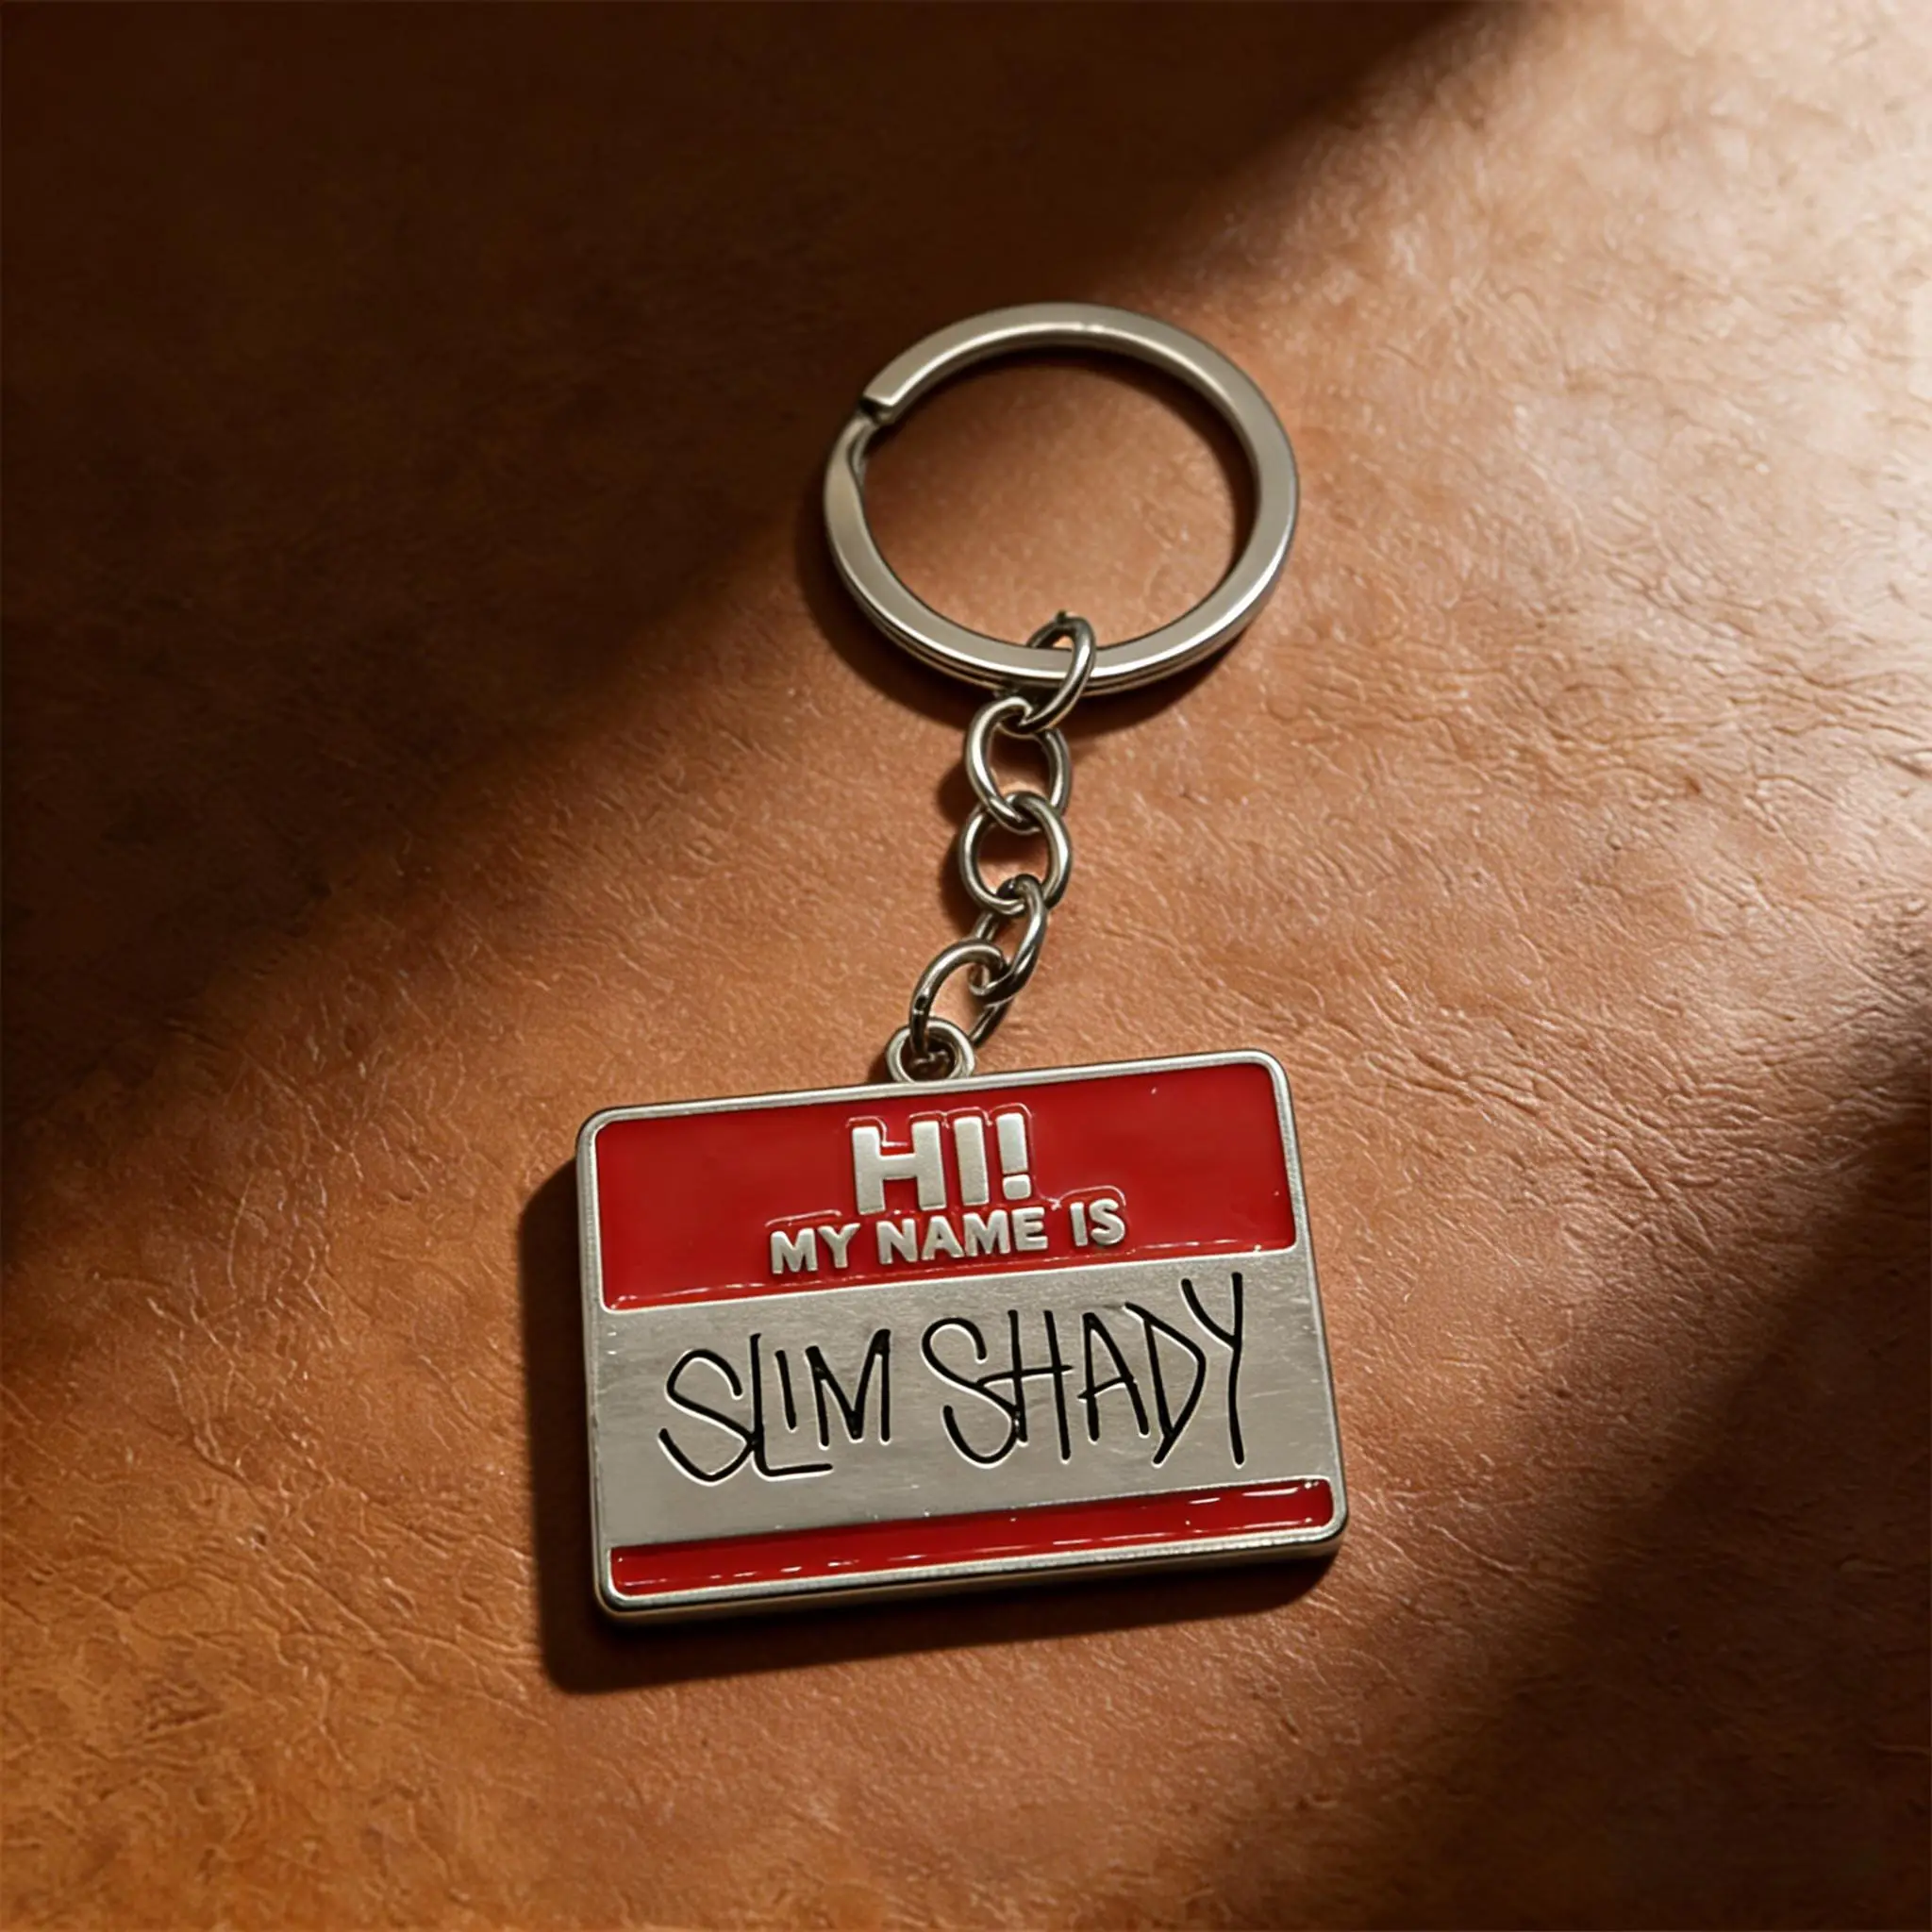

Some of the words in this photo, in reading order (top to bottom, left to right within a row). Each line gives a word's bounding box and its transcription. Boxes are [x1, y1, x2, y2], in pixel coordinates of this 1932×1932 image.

[852, 1112, 1032, 1215] HI!
[770, 1223, 861, 1274] MY
[875, 1207, 1048, 1265] NAME
[1070, 1198, 1125, 1247] IS
[658, 1328, 891, 1482] SLIM
[922, 1272, 1243, 1466] SHADY
